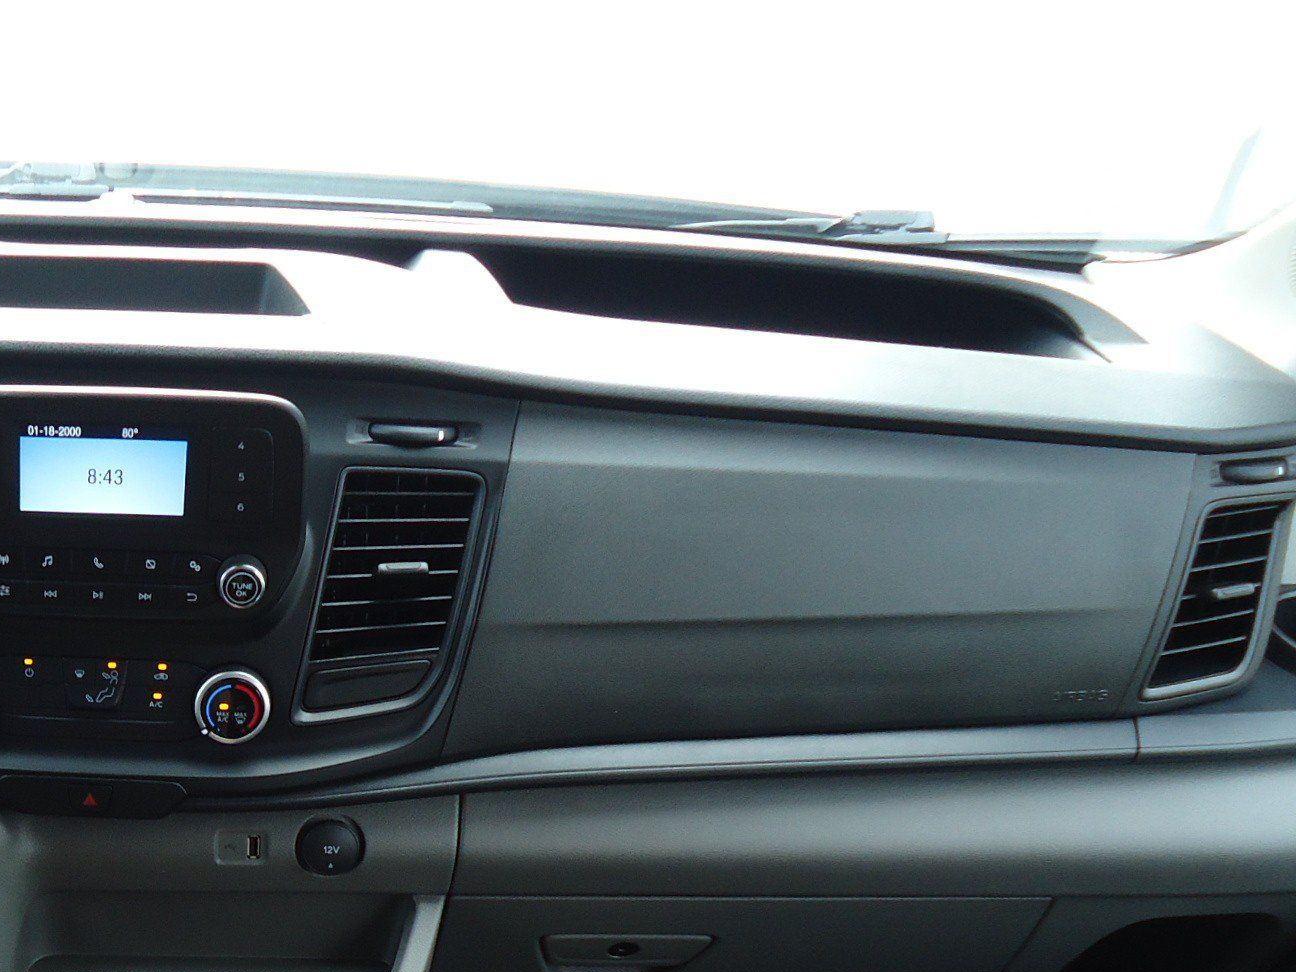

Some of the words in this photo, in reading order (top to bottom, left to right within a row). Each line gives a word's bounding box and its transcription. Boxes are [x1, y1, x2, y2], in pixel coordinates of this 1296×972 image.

[27, 425, 82, 437] 01-18-2000
[237, 442, 244, 450] 4
[87, 468, 123, 485] 8:43
[238, 473, 245, 482] 5
[237, 502, 244, 512] 6
[232, 582, 252, 590] TUNE
[323, 846, 340, 855] 12V
